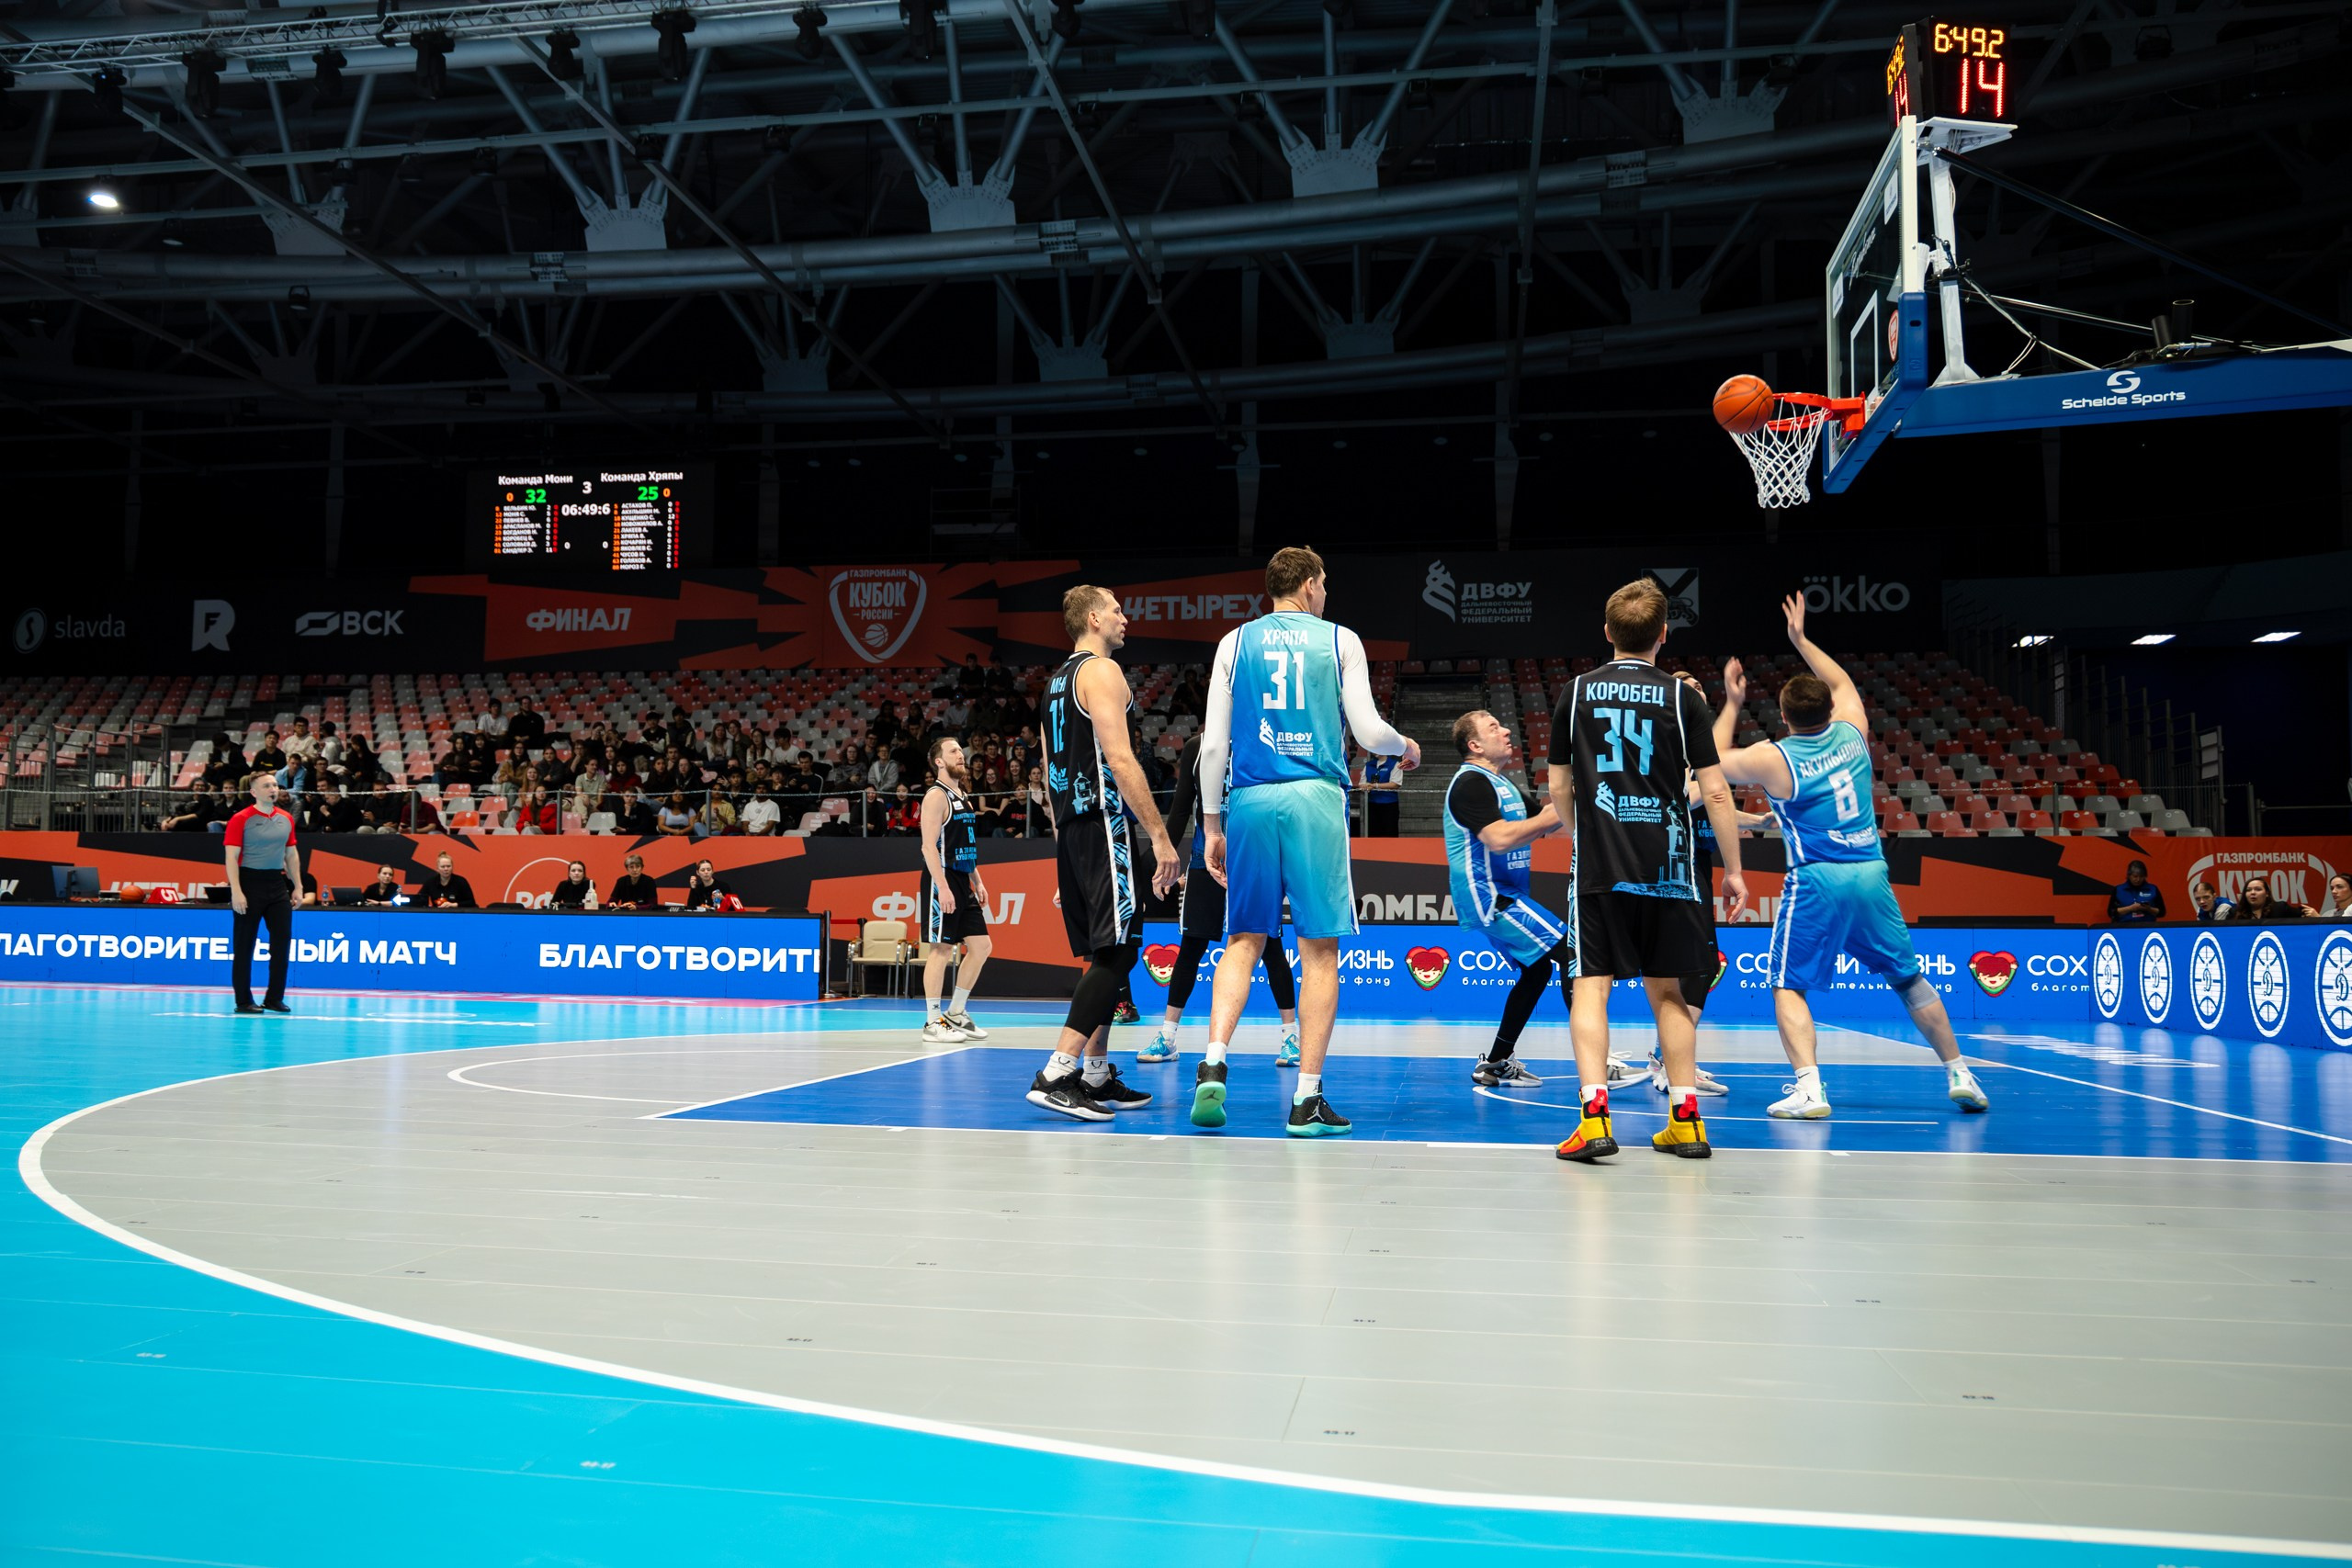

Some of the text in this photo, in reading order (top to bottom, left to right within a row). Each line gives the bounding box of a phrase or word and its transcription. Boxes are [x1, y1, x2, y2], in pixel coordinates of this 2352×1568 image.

[1934, 23, 2004, 59] 6:49.2
[1961, 58, 2004, 118] 14
[2062, 390, 2186, 410] Schelde Sports
[498, 474, 573, 486] Команда Мони
[600, 470, 684, 483] Команда Хряпы
[506, 488, 547, 504] 0 32
[582, 480, 593, 494] 3
[638, 486, 671, 501] 25 0
[561, 503, 611, 516] 06:49:6
[849, 569, 908, 578] ГАЗПРОМБАНК
[849, 581, 907, 608] КУБОК
[1461, 581, 1532, 601] ДВФУ
[861, 609, 893, 620] РОССИИ
[1123, 593, 1265, 622] ЧЕТЫРЕХ
[1461, 607, 1532, 615] ФЕДЕРАЛЬНЫЙ
[54, 614, 126, 638] slavda
[342, 610, 404, 637] ВСК
[526, 607, 632, 632] ФИНАЛ
[1461, 615, 1532, 624] УНИВЕРСИТЕТ
[1261, 629, 1309, 646] ХРЯПА
[1262, 650, 1305, 710] 31
[1586, 682, 1665, 707] КОРОБЕЦ
[1276, 731, 1313, 743] ДВФУ
[1593, 707, 1654, 776] 34
[1798, 739, 1863, 779] АКУЛЬШИН
[1618, 795, 1660, 808] ДВФУ
[1828, 769, 1860, 823] 8
[2216, 852, 2306, 864] ГАЗПРОМБАНК
[359, 940, 457, 965] МАТЧ
[1353, 976, 1391, 987] фонд
